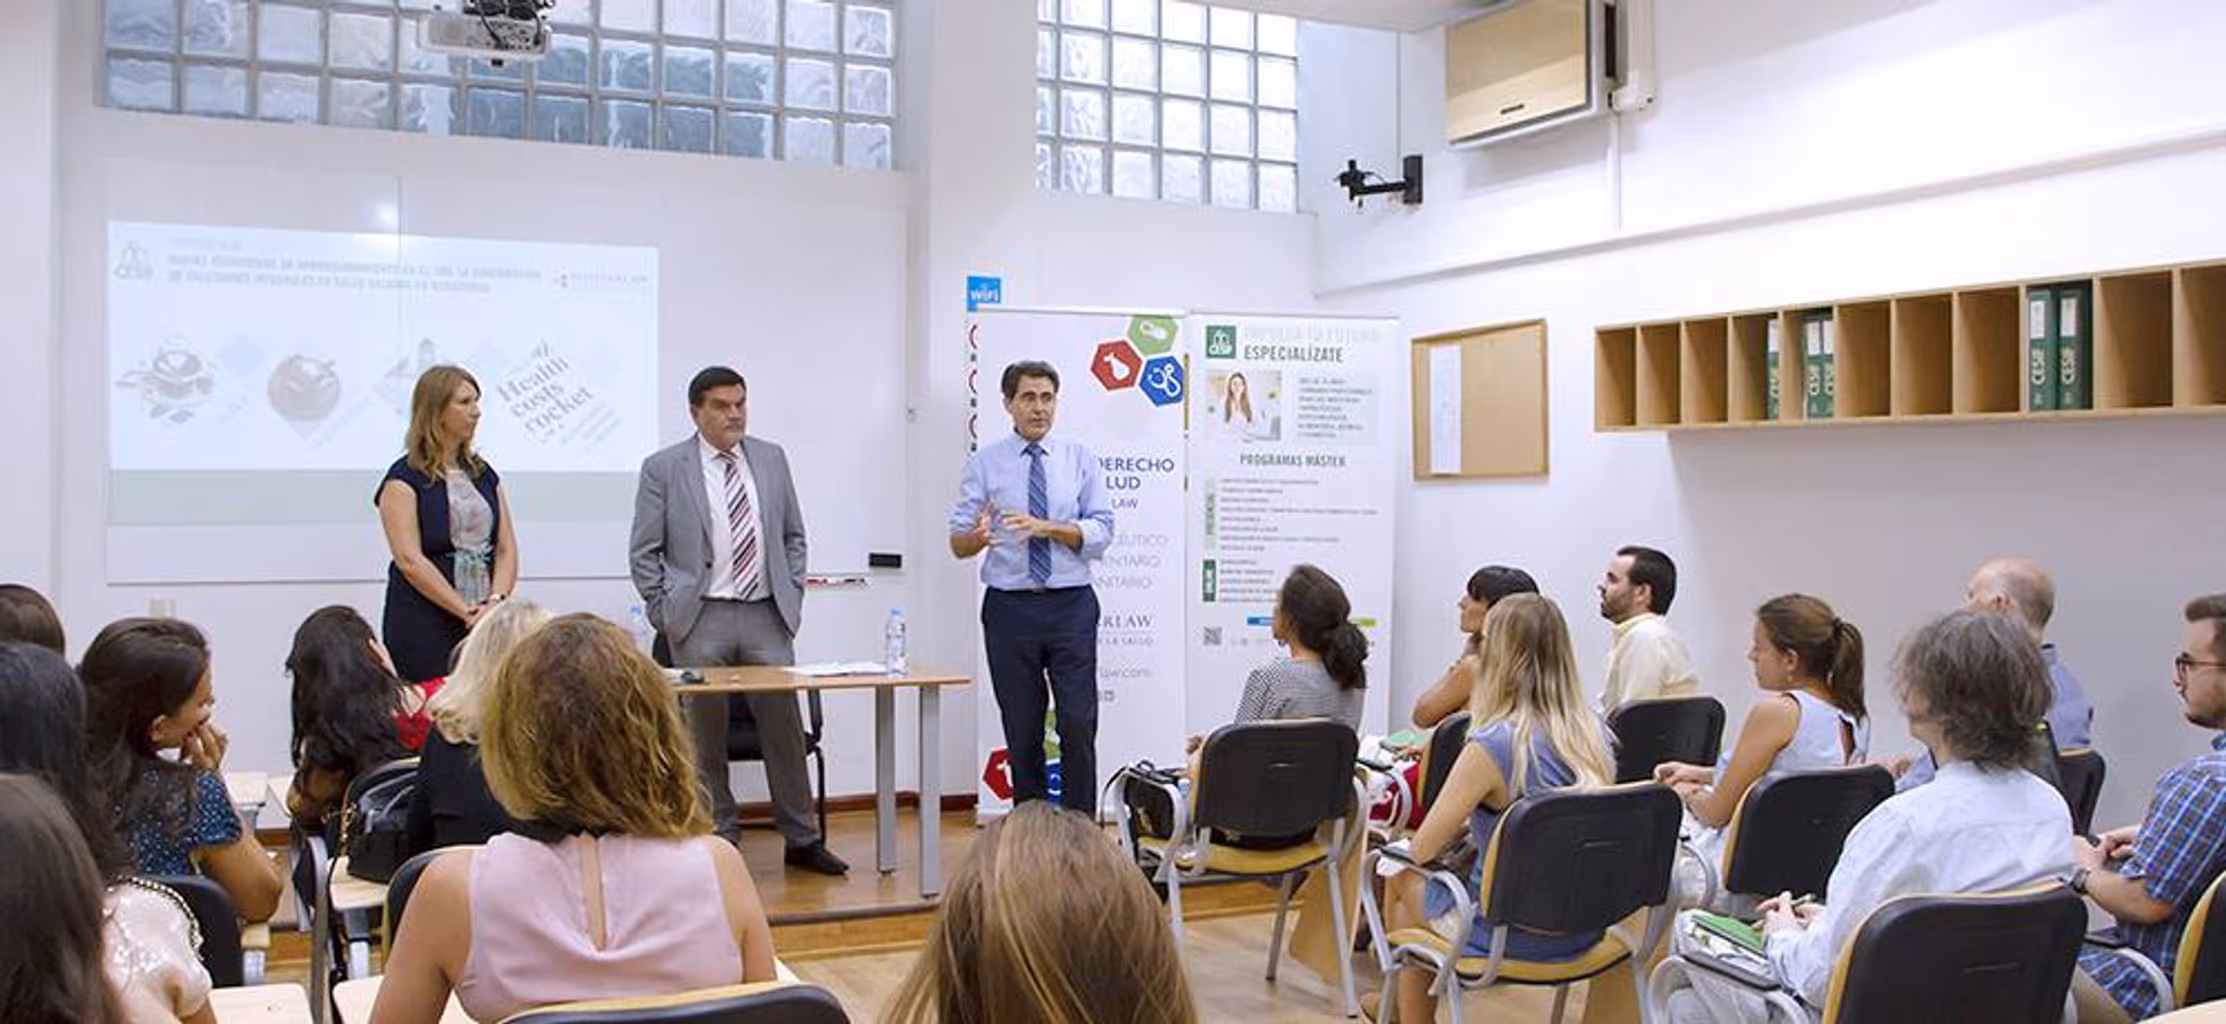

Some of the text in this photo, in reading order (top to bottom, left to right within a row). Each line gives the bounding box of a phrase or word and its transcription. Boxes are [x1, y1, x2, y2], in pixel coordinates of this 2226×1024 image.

[496, 356, 571, 402] Health
[511, 383, 565, 418] costs
[524, 386, 595, 433] rocket
[1105, 475, 1141, 491] LUD
[1102, 614, 1152, 628] RLAW
